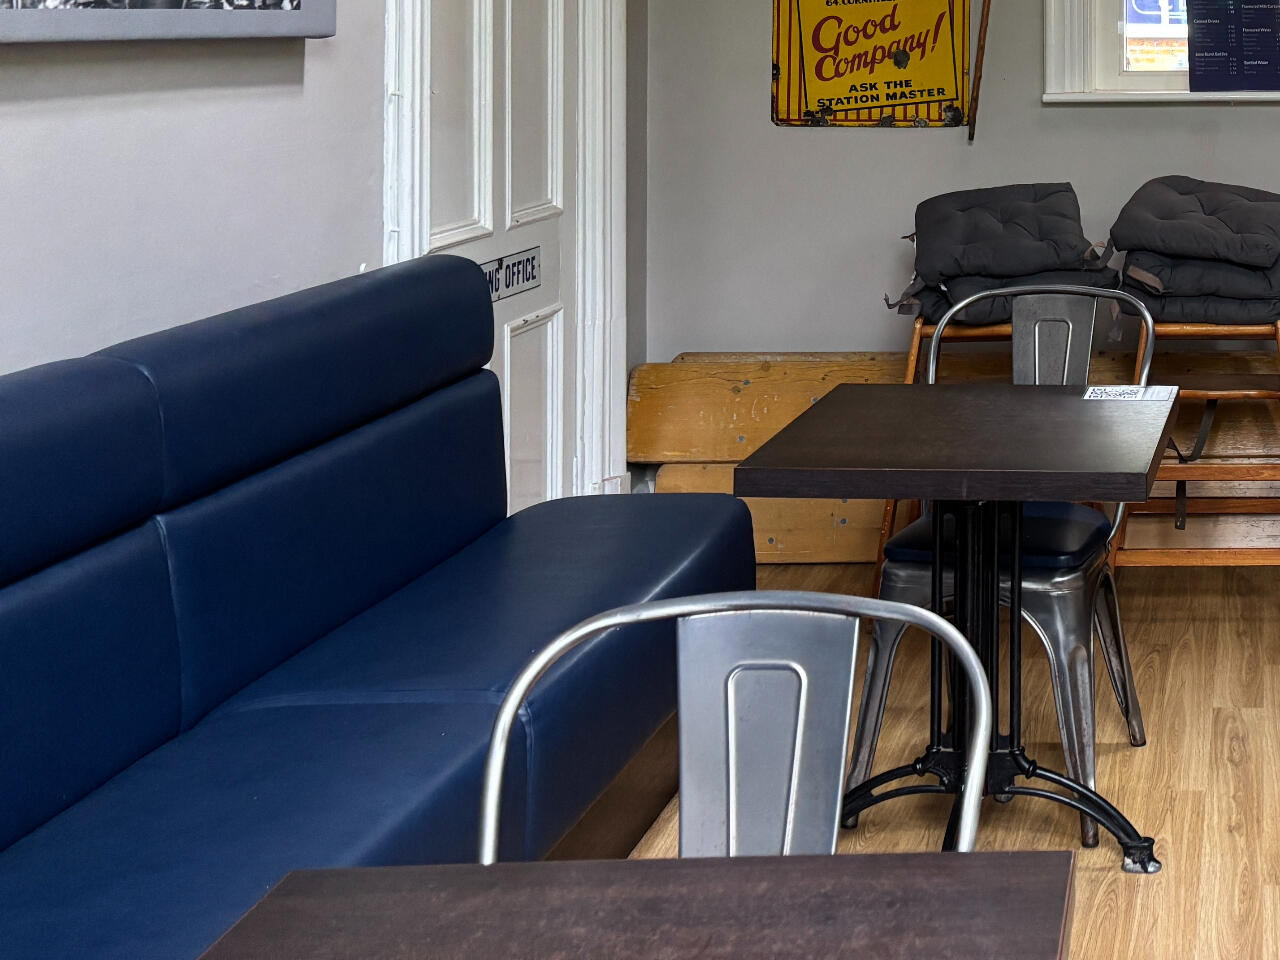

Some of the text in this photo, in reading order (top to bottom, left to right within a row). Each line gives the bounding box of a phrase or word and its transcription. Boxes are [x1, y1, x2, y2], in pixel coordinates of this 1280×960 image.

[812, 3, 901, 57] Good
[815, 11, 947, 82] Company!
[817, 88, 946, 108] STATION MASTER
[849, 80, 912, 93] ASK THE
[505, 256, 537, 289] OFFICE
